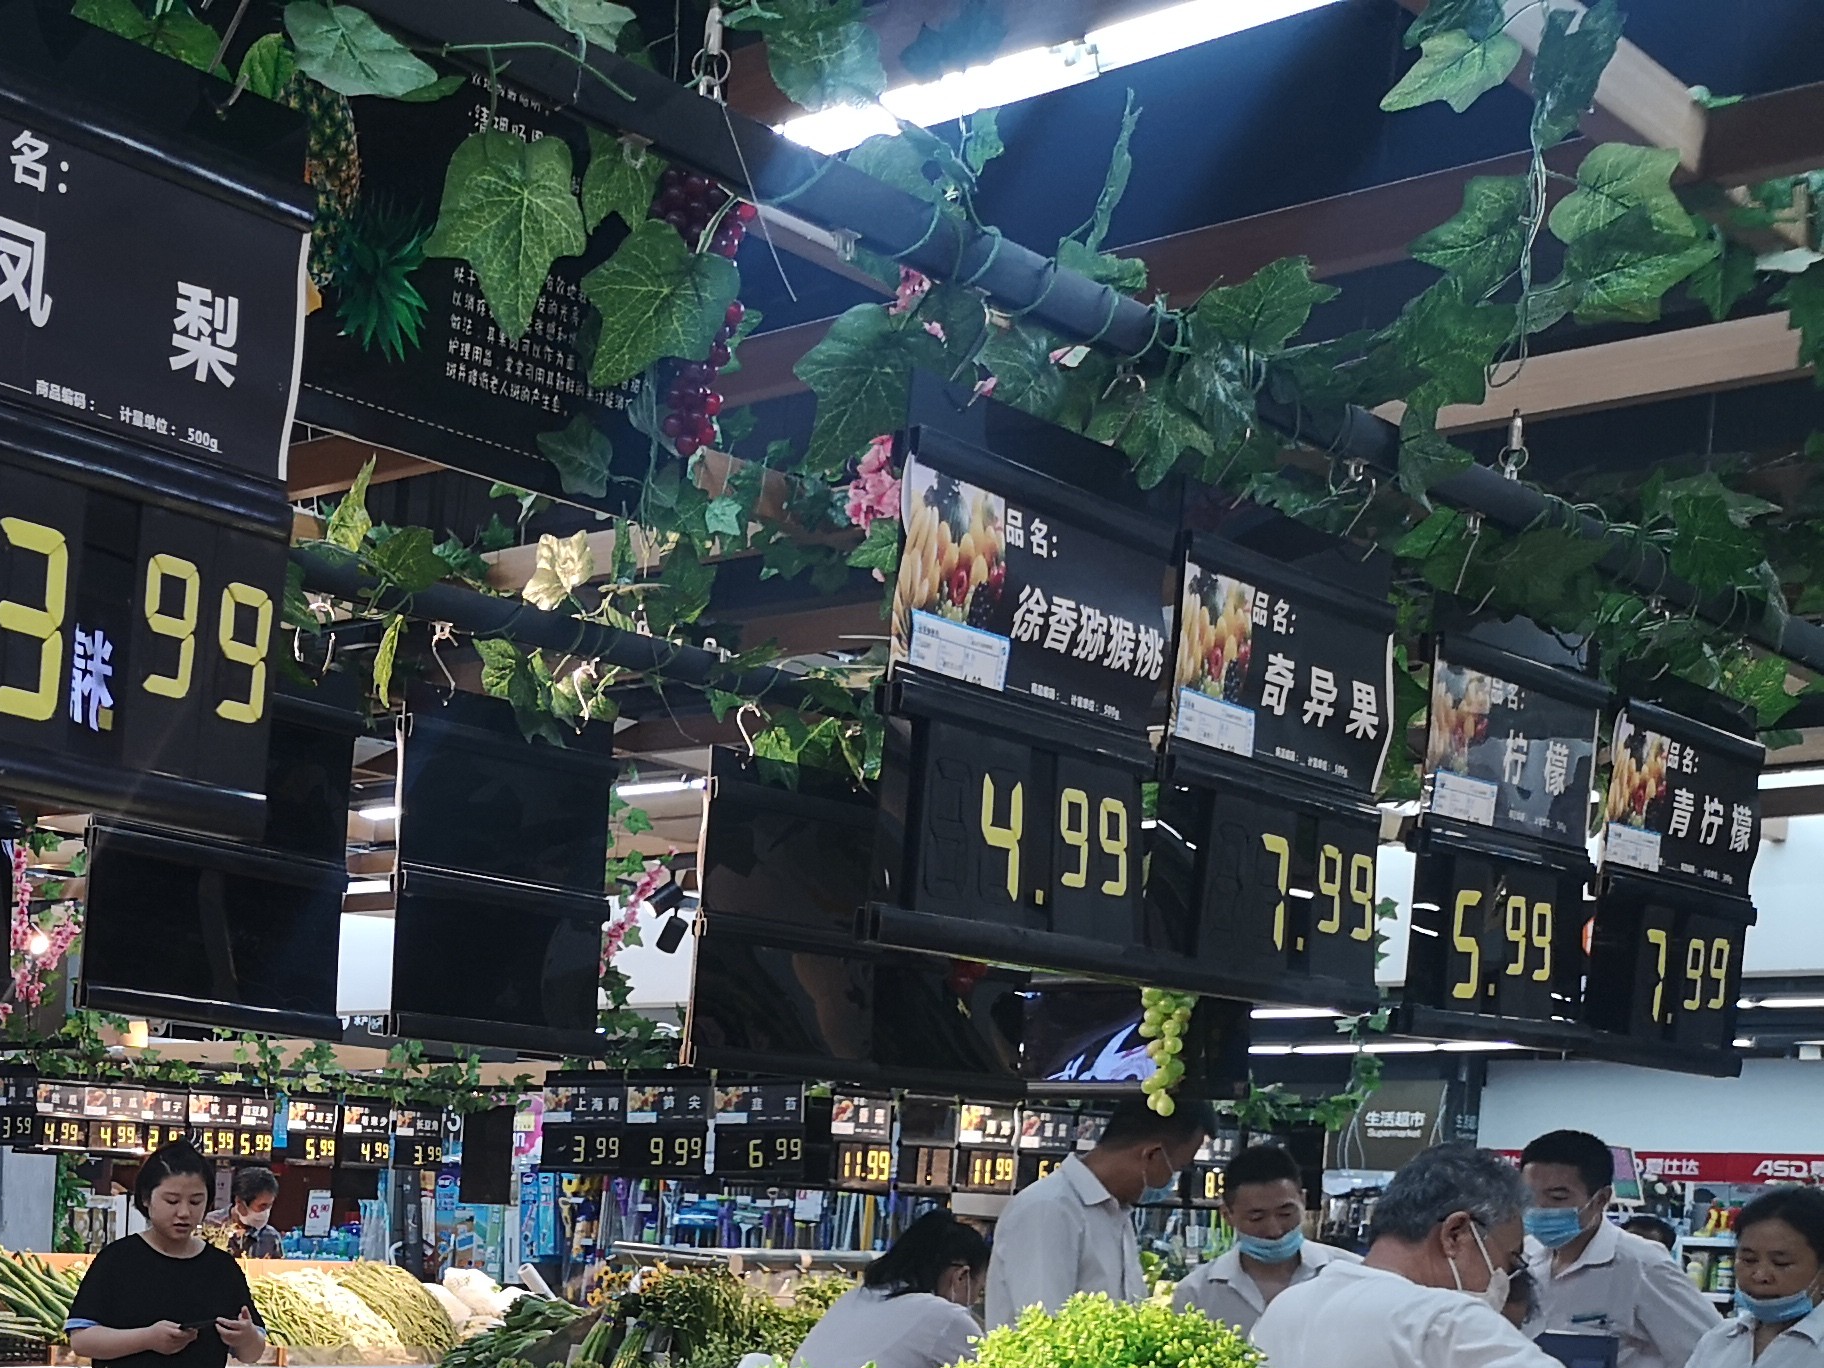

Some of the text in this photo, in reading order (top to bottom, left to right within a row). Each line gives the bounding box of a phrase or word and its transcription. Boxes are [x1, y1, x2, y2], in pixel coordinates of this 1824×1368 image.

[187, 427, 219, 452] 500g
[1010, 585, 1165, 681] 徐香猕猴桃
[1261, 653, 1381, 742] 奇异果
[1501, 729, 1570, 796] 柠檬
[1667, 787, 1753, 853] 青柠檬
[981, 774, 1128, 906] 4.99
[1261, 832, 1375, 953] 7.99
[1452, 888, 1553, 1000] 5.99
[1646, 928, 1731, 1025] 7.99
[44, 1122, 78, 1143] 4.99
[1365, 1111, 1426, 1128] 生活超市
[100, 1126, 136, 1147] 4.99
[203, 1132, 234, 1154] 5.99
[240, 1133, 272, 1155] 5.99
[305, 1138, 335, 1160] 5.99
[572, 1135, 619, 1163] 3.99
[361, 1142, 389, 1163] 4.99
[650, 1137, 702, 1166] 9.99
[748, 1138, 802, 1168] 6.99
[844, 1150, 891, 1181] 11.99
[974, 1158, 1013, 1185] 11.99
